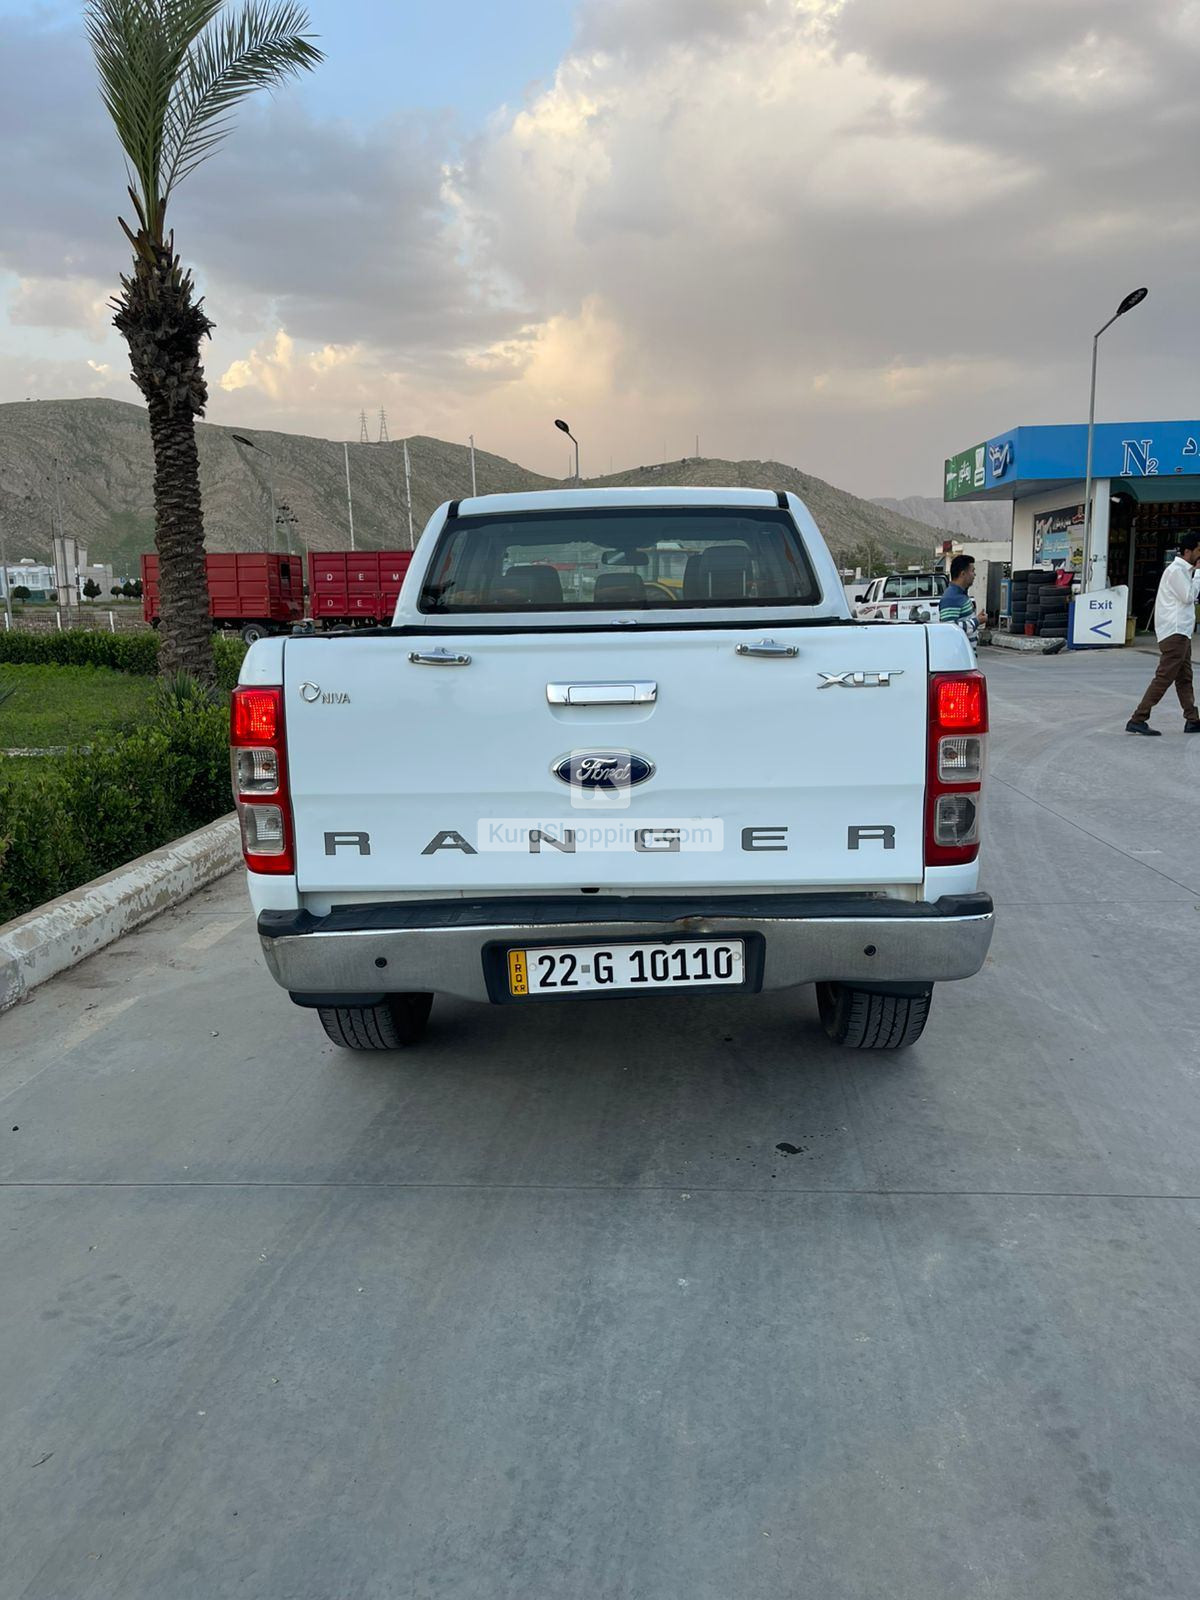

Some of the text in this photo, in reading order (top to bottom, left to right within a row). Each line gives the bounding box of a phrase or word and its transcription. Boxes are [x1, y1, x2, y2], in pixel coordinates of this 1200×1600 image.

[1089, 599, 1113, 610] Exit
[816, 669, 905, 689] XLT
[576, 757, 631, 781] Ford
[324, 825, 896, 856] RANGER
[629, 946, 733, 983] 10110
